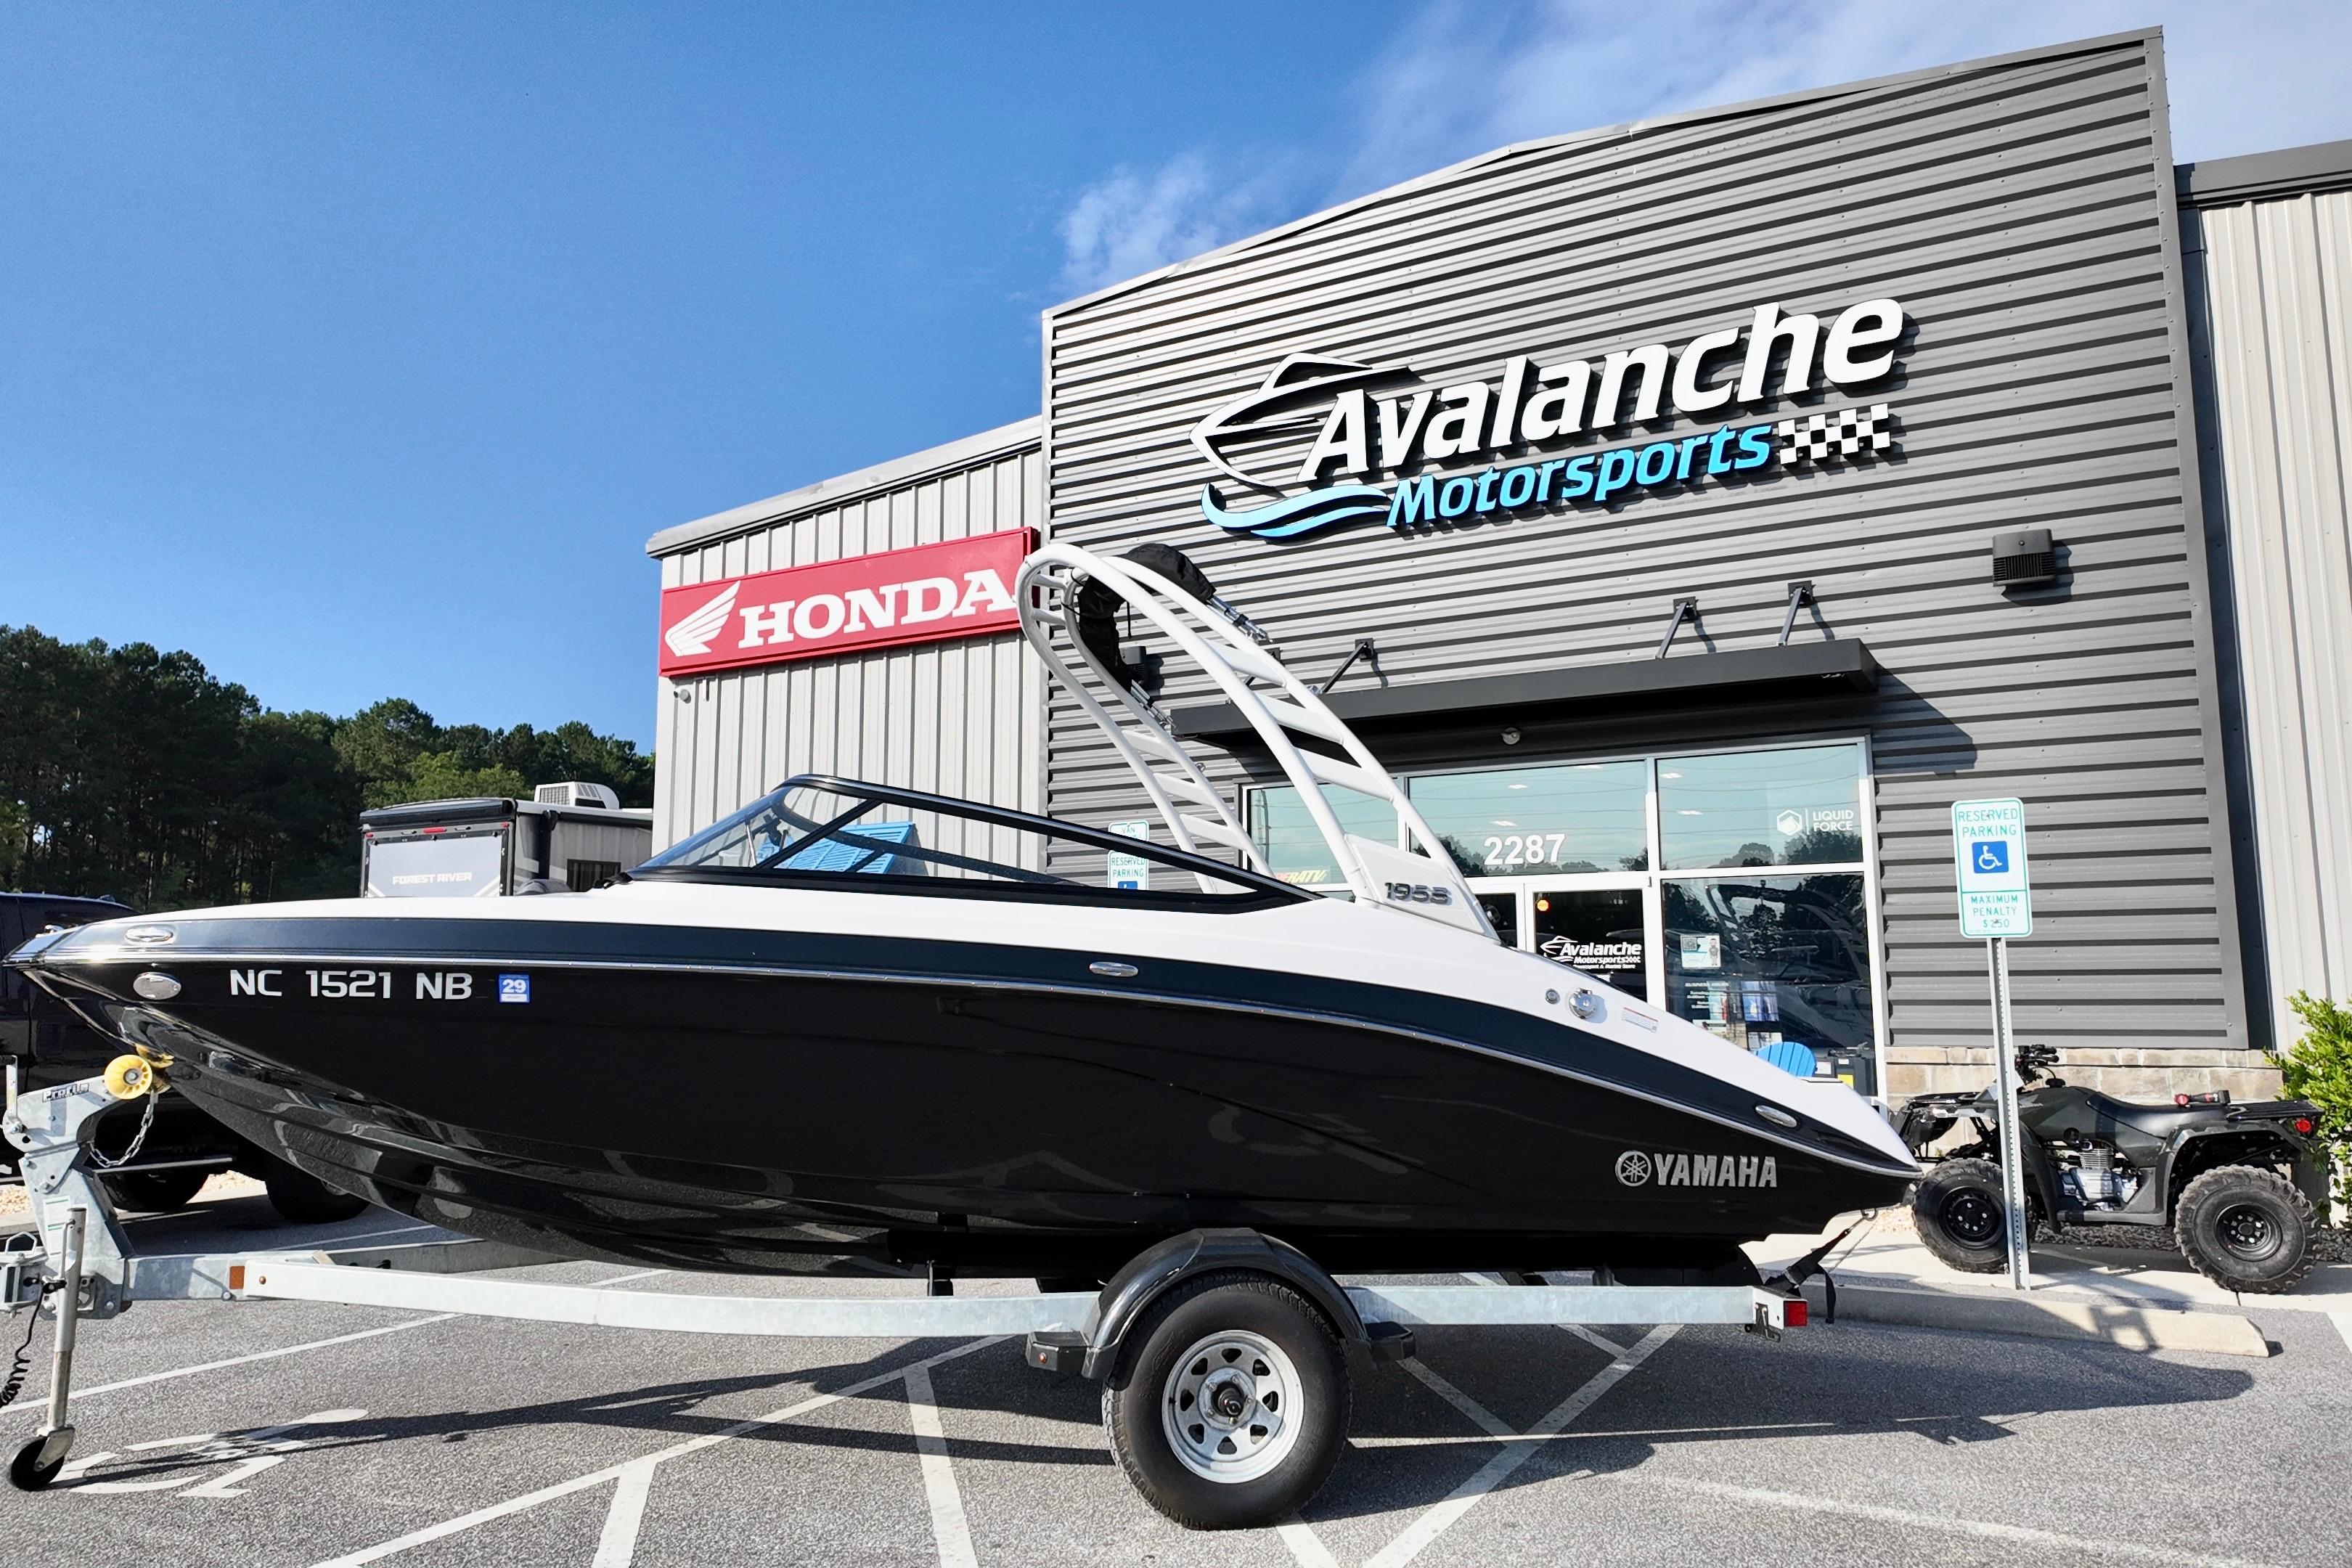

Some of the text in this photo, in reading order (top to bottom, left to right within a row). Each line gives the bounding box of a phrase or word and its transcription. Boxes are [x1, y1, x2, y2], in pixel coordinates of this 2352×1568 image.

[1297, 298, 1903, 483] Avalanche
[1385, 424, 1773, 527] Motorsports
[738, 568, 1017, 649] HONDA
[1813, 809, 1855, 821] LIQUID
[1959, 808, 2018, 822] RESERVED
[1813, 821, 1853, 832] FORCE
[1962, 824, 2017, 838] PARKING
[1484, 833, 1566, 865] 2287
[1111, 856, 1146, 867] RESERVED
[392, 872, 472, 885] FOREST RIVER
[1113, 869, 1144, 878] PARKING
[1970, 894, 2019, 905] MAXIMUM
[1972, 907, 2017, 917] PENALTY
[1560, 941, 1642, 956] Avalanche
[1573, 956, 1625, 965] Motorsports
[230, 969, 473, 1000] NC 1521 NB
[502, 979, 526, 993] 29
[1654, 1153, 1777, 1188] YAMAHA
